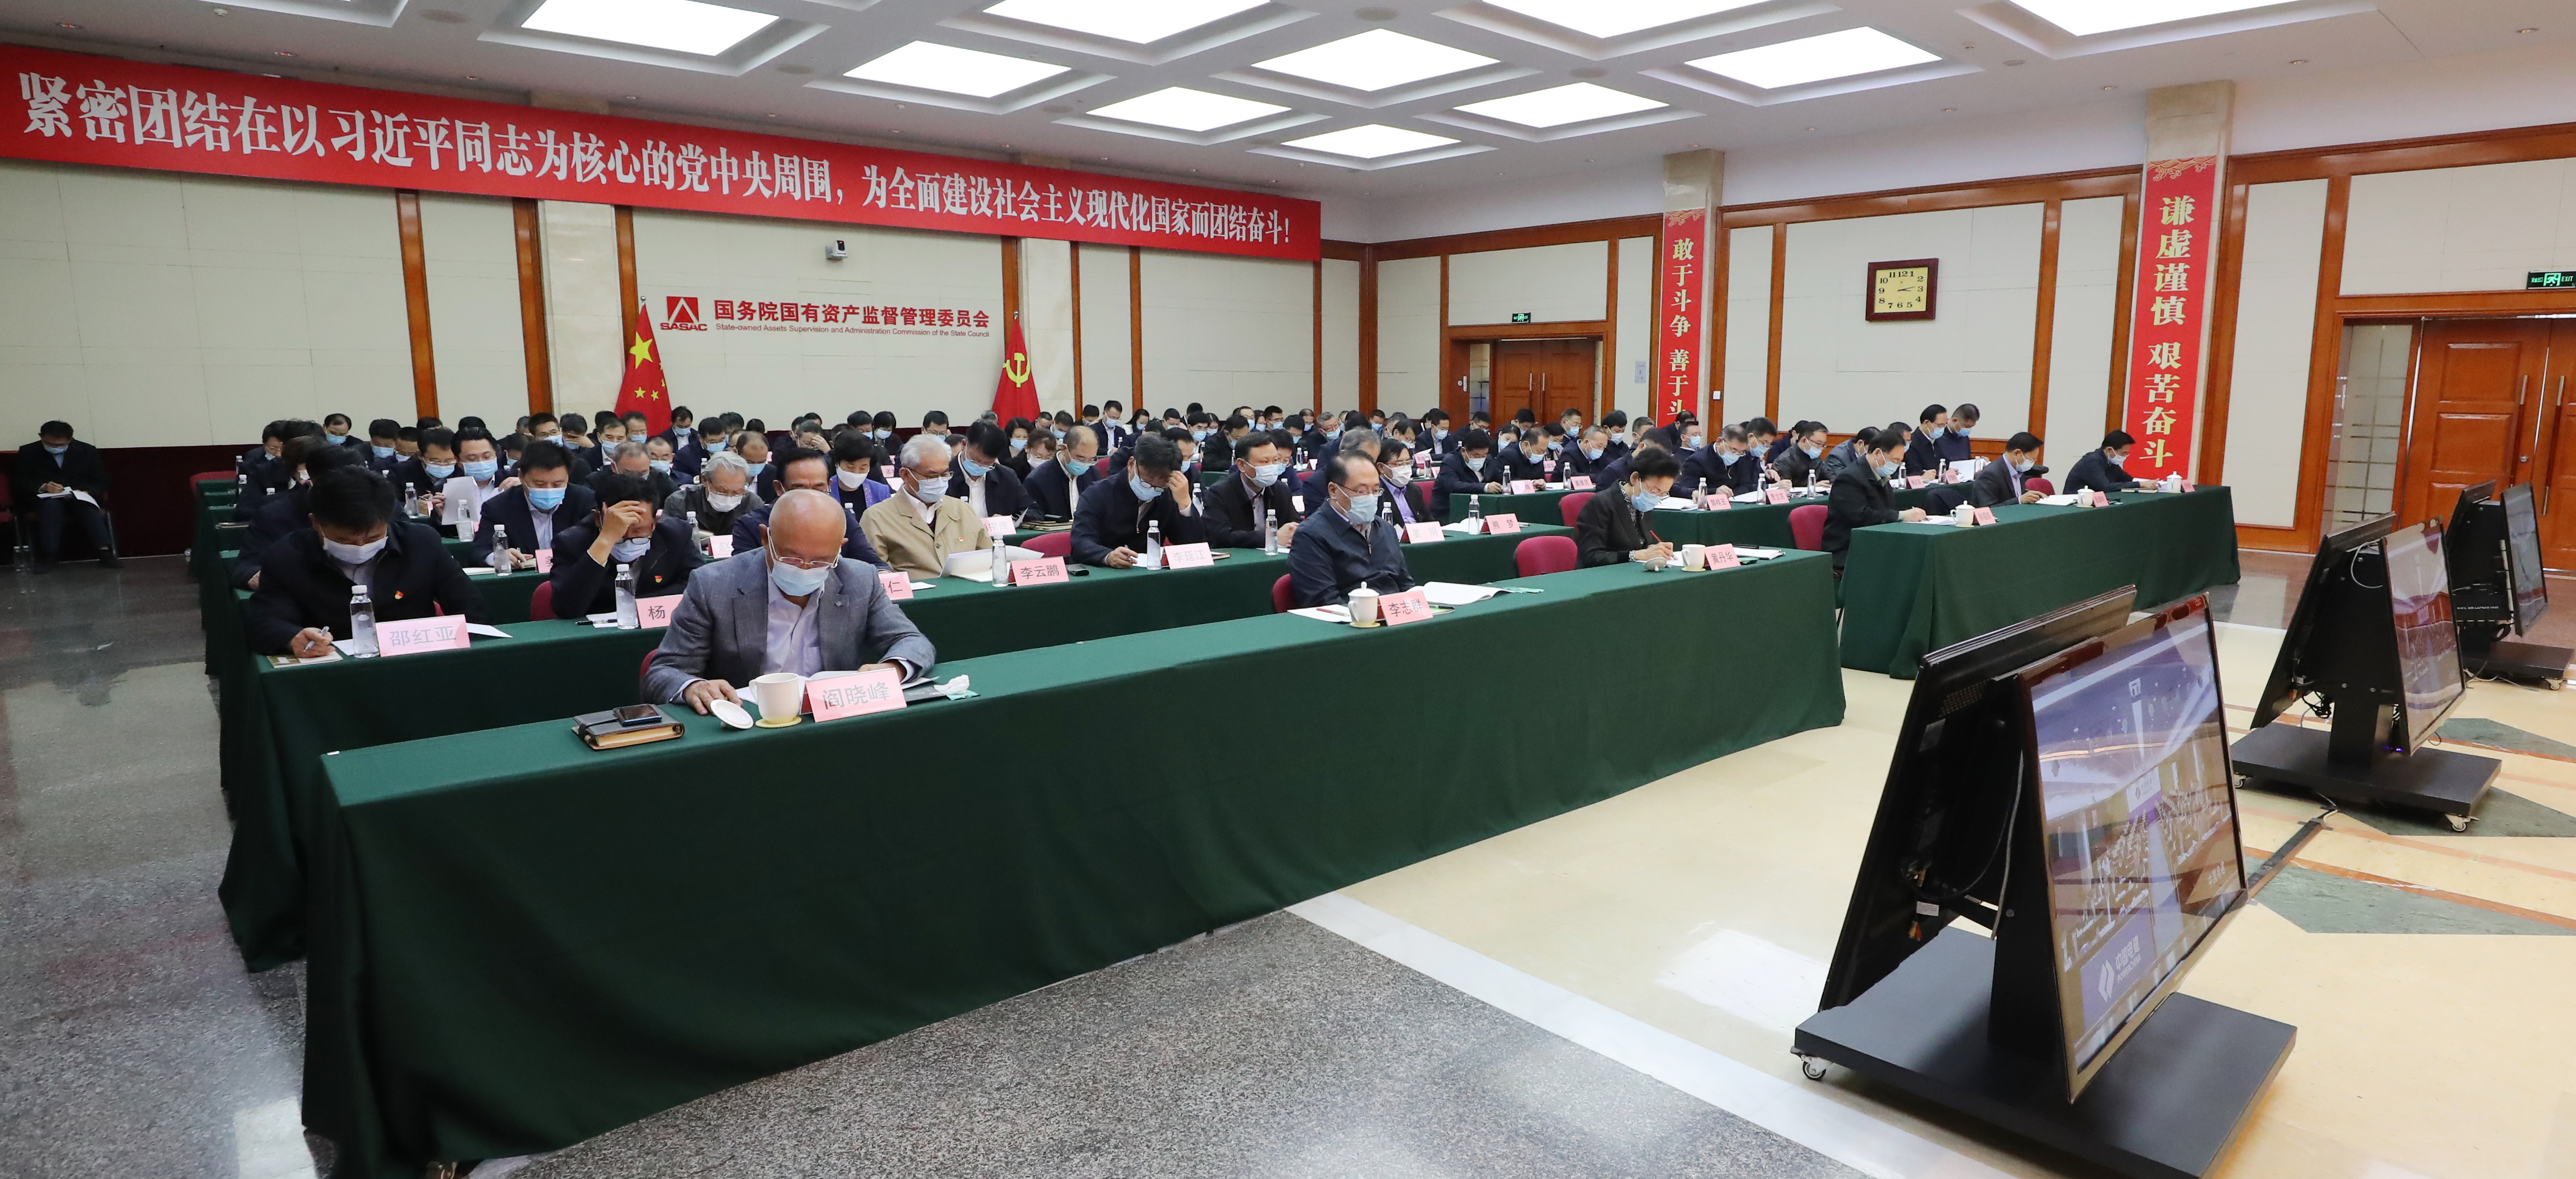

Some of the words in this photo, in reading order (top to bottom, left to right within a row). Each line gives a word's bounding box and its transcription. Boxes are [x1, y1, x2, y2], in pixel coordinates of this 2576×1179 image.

[2151, 196, 2195, 326] 谦虚谨慎
[1671, 238, 1694, 337] 敢于斗争
[714, 300, 989, 328] 国务院国有资产监督管理委员会
[660, 322, 708, 331] SASAC
[789, 325, 828, 333] Supervision
[2139, 342, 2182, 468] 艰苦奋斗
[1173, 550, 1206, 563] 李延江
[1711, 551, 1734, 564] 黄丹华
[1020, 564, 1060, 579] 李云鹏
[648, 605, 666, 620] 杨
[1388, 598, 1423, 618] 李志群
[389, 625, 456, 647] 邵红亚
[822, 681, 890, 710] 阎晓峰
[2116, 935, 2140, 971] 中国电建
